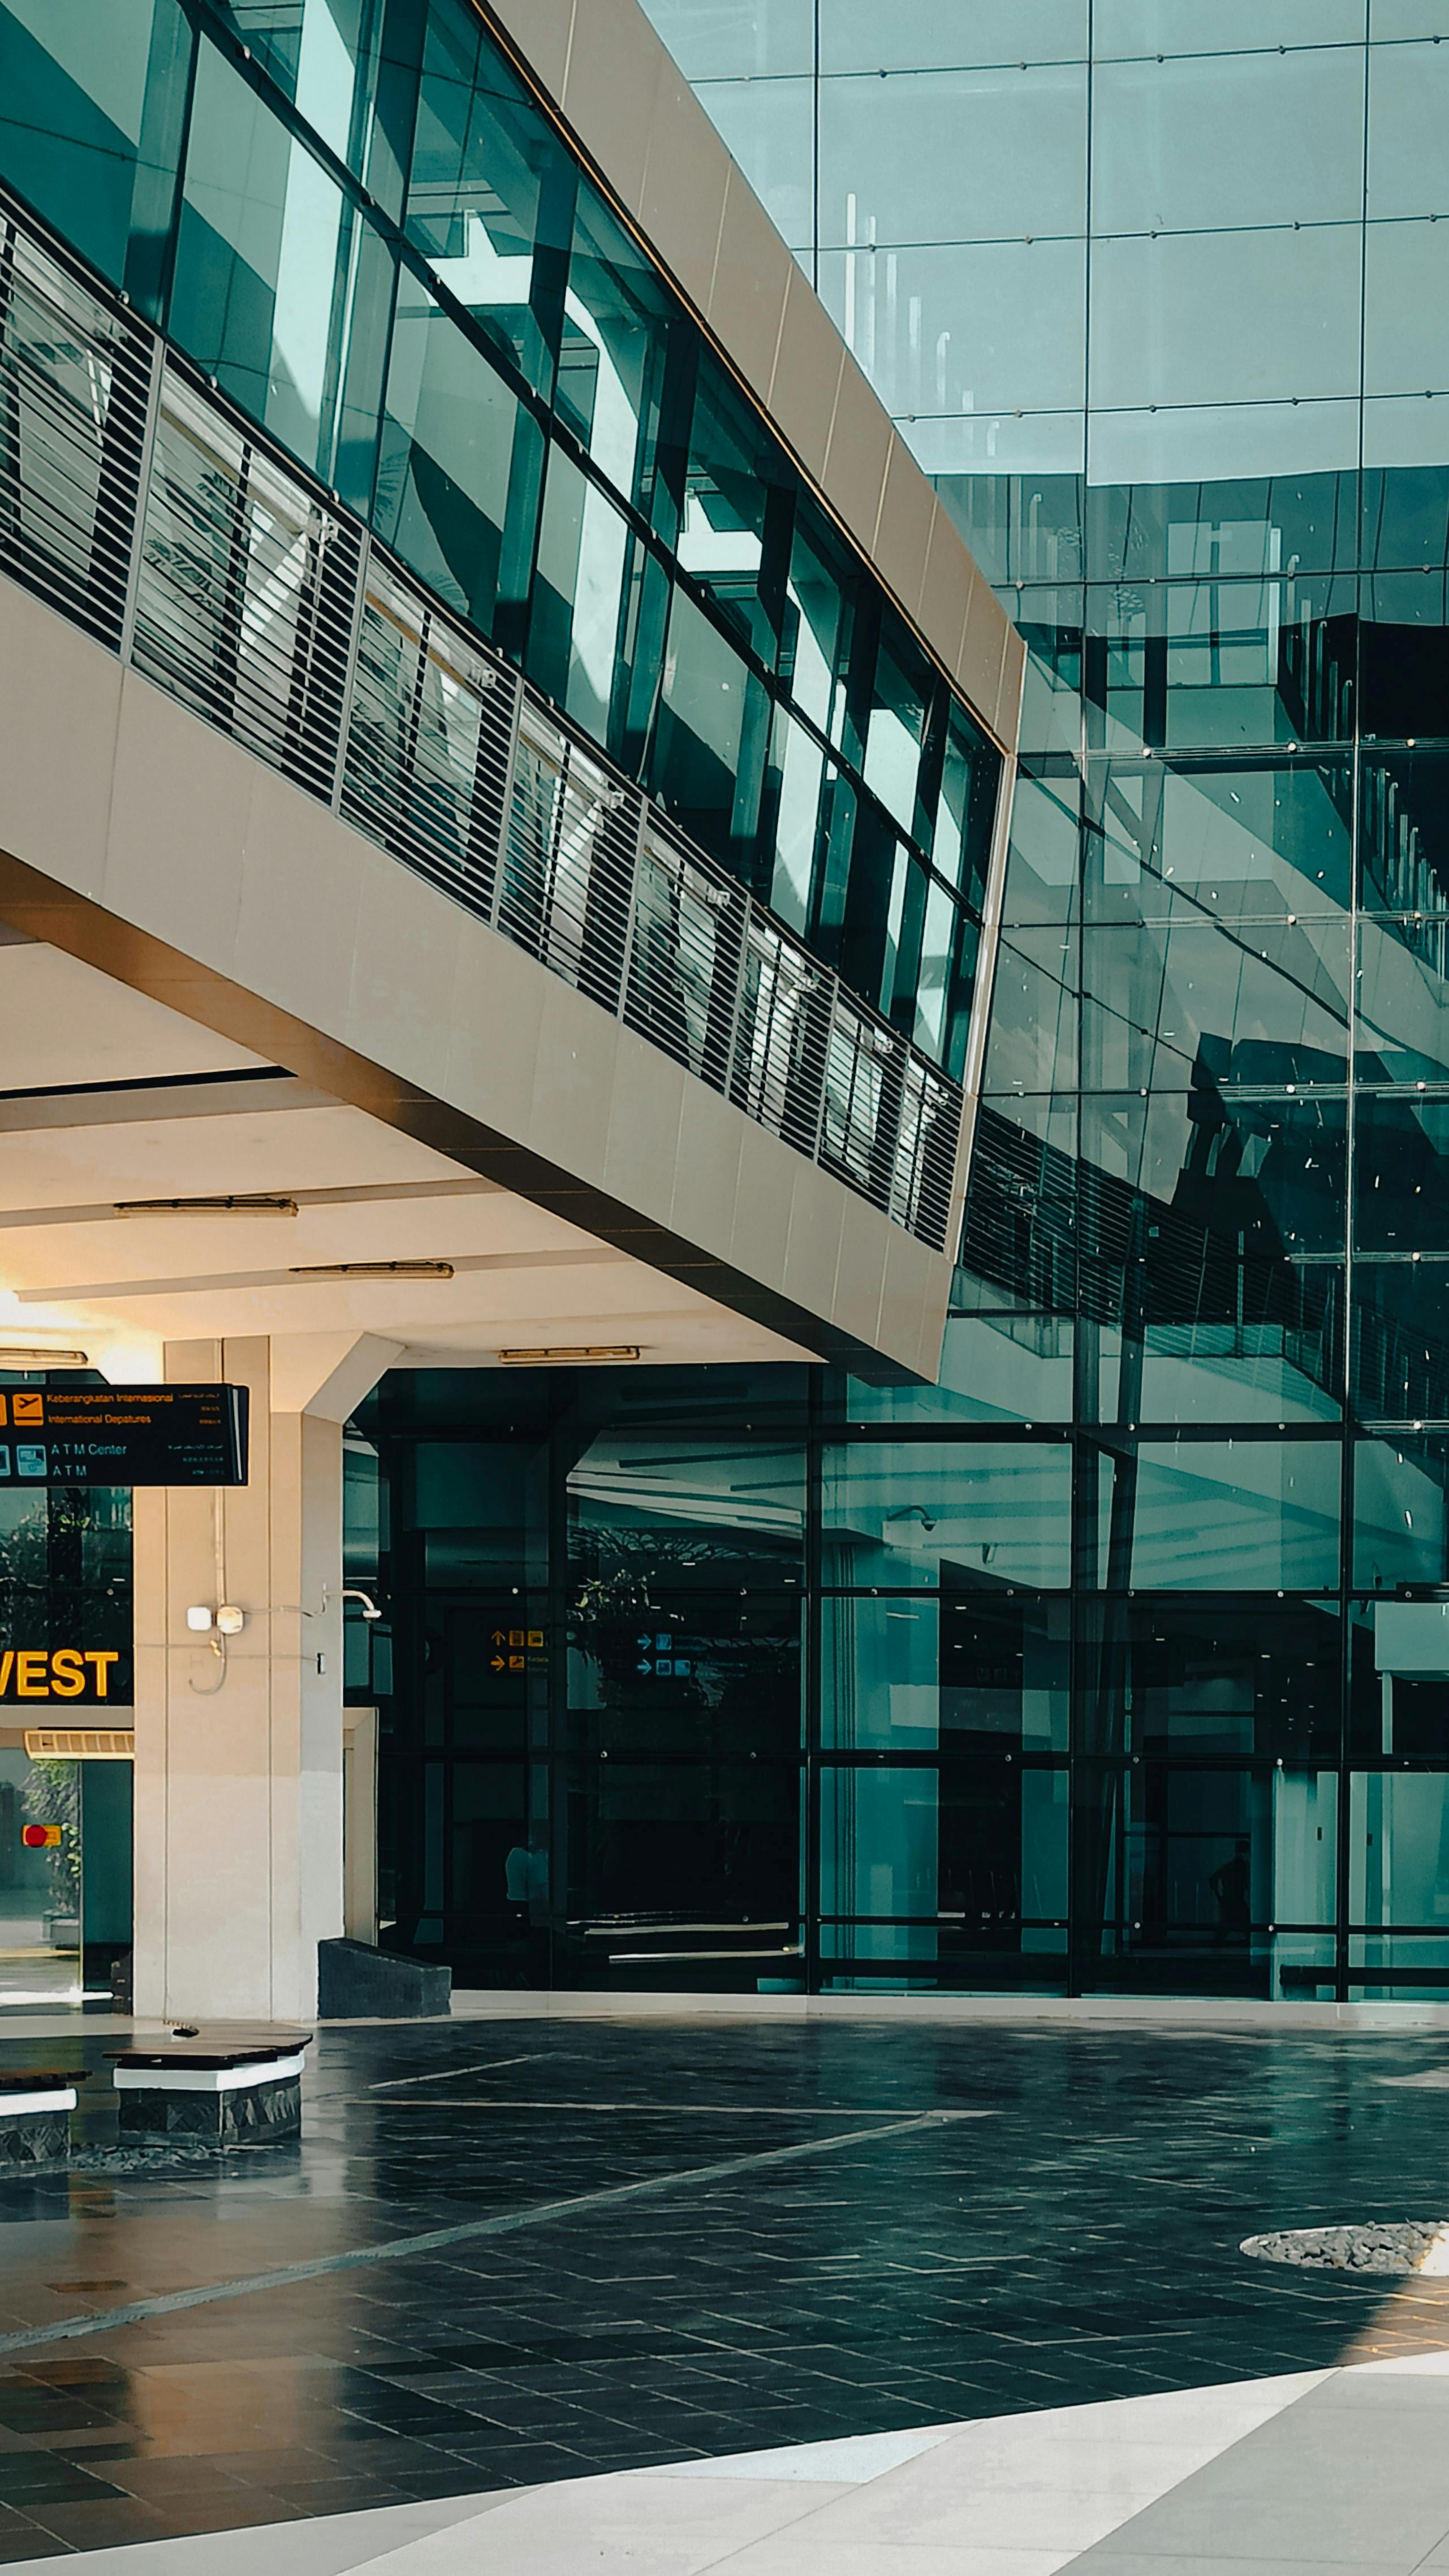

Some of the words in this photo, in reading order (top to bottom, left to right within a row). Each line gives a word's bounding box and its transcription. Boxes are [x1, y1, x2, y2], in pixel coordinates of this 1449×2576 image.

[116, 1393, 173, 1403] Internasional
[48, 1414, 102, 1424] International
[88, 1443, 127, 1455] Center
[0, 1649, 119, 1697] EST
